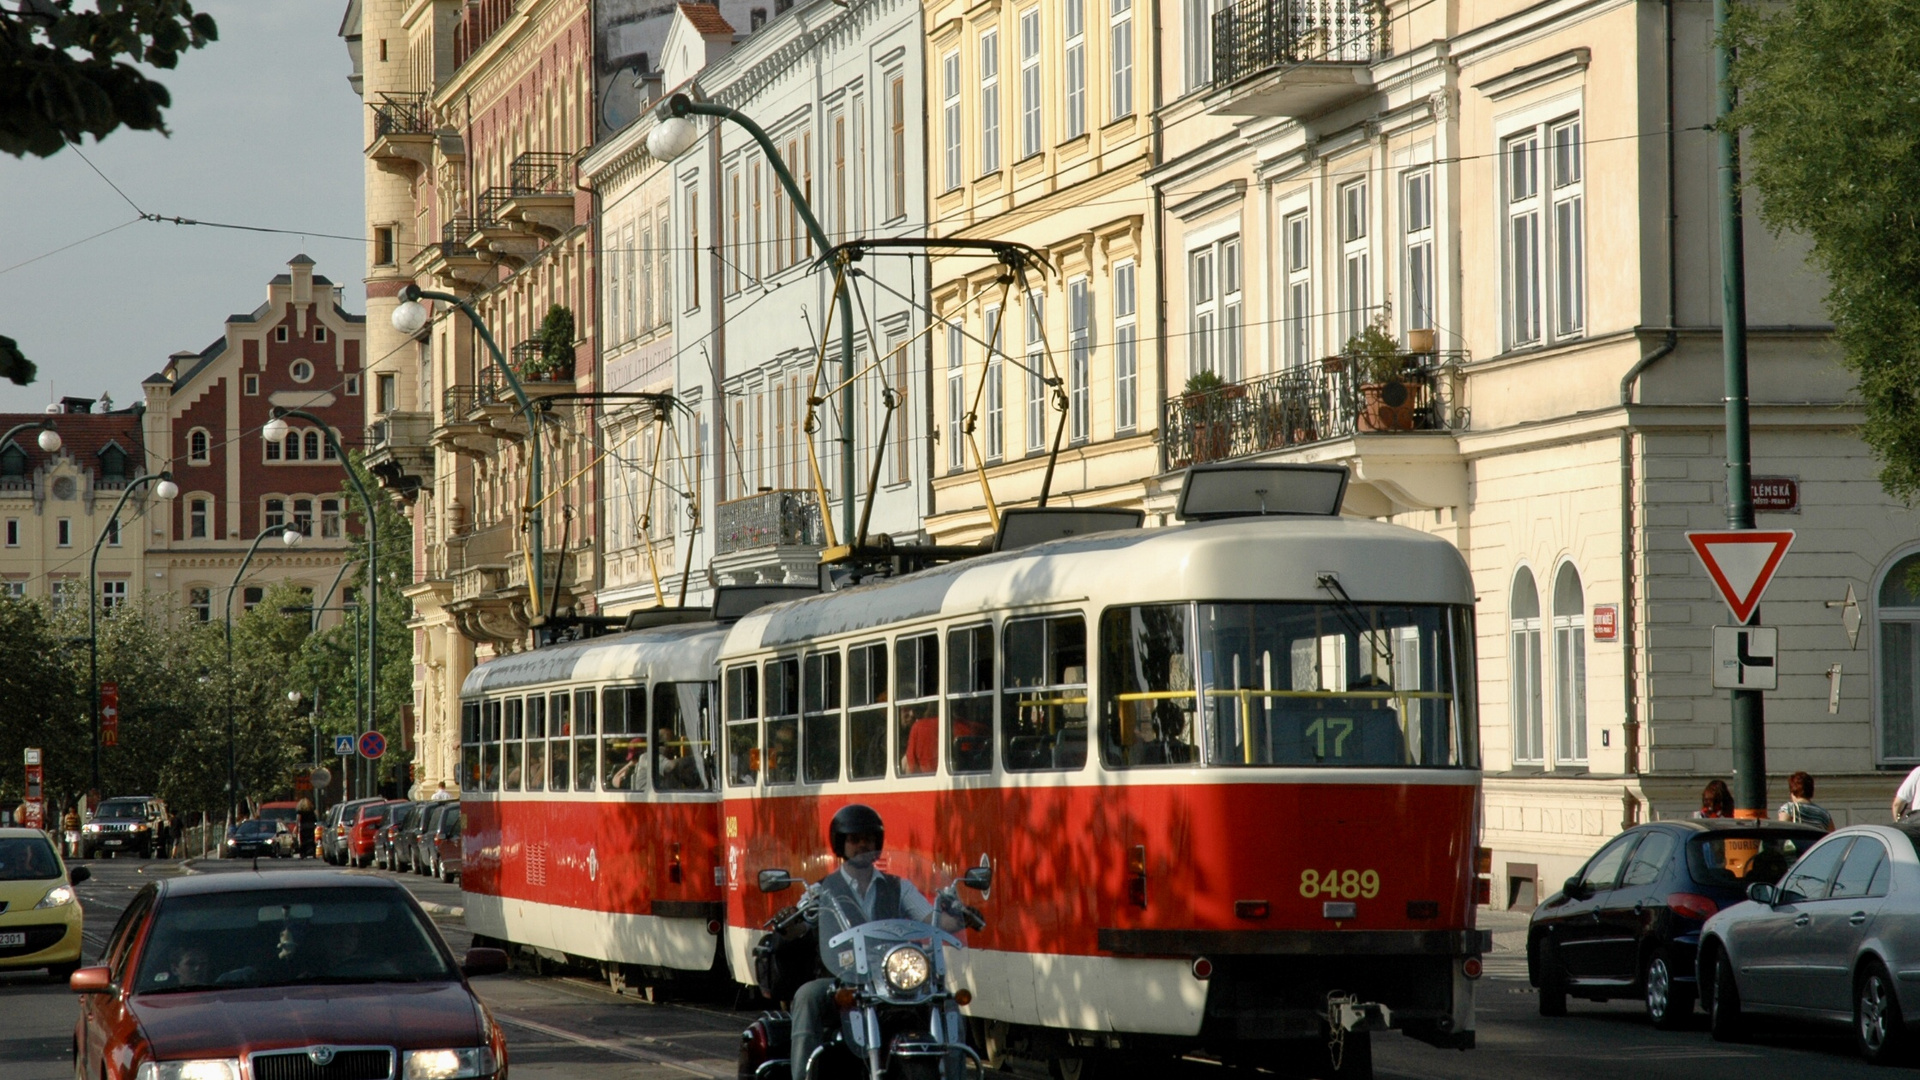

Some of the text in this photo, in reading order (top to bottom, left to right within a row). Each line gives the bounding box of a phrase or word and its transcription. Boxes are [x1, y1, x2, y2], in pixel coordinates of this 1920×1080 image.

[1751, 484, 1790, 497] LÉMSKÁ
[1305, 717, 1354, 758] 17
[1299, 868, 1380, 899] 8489
